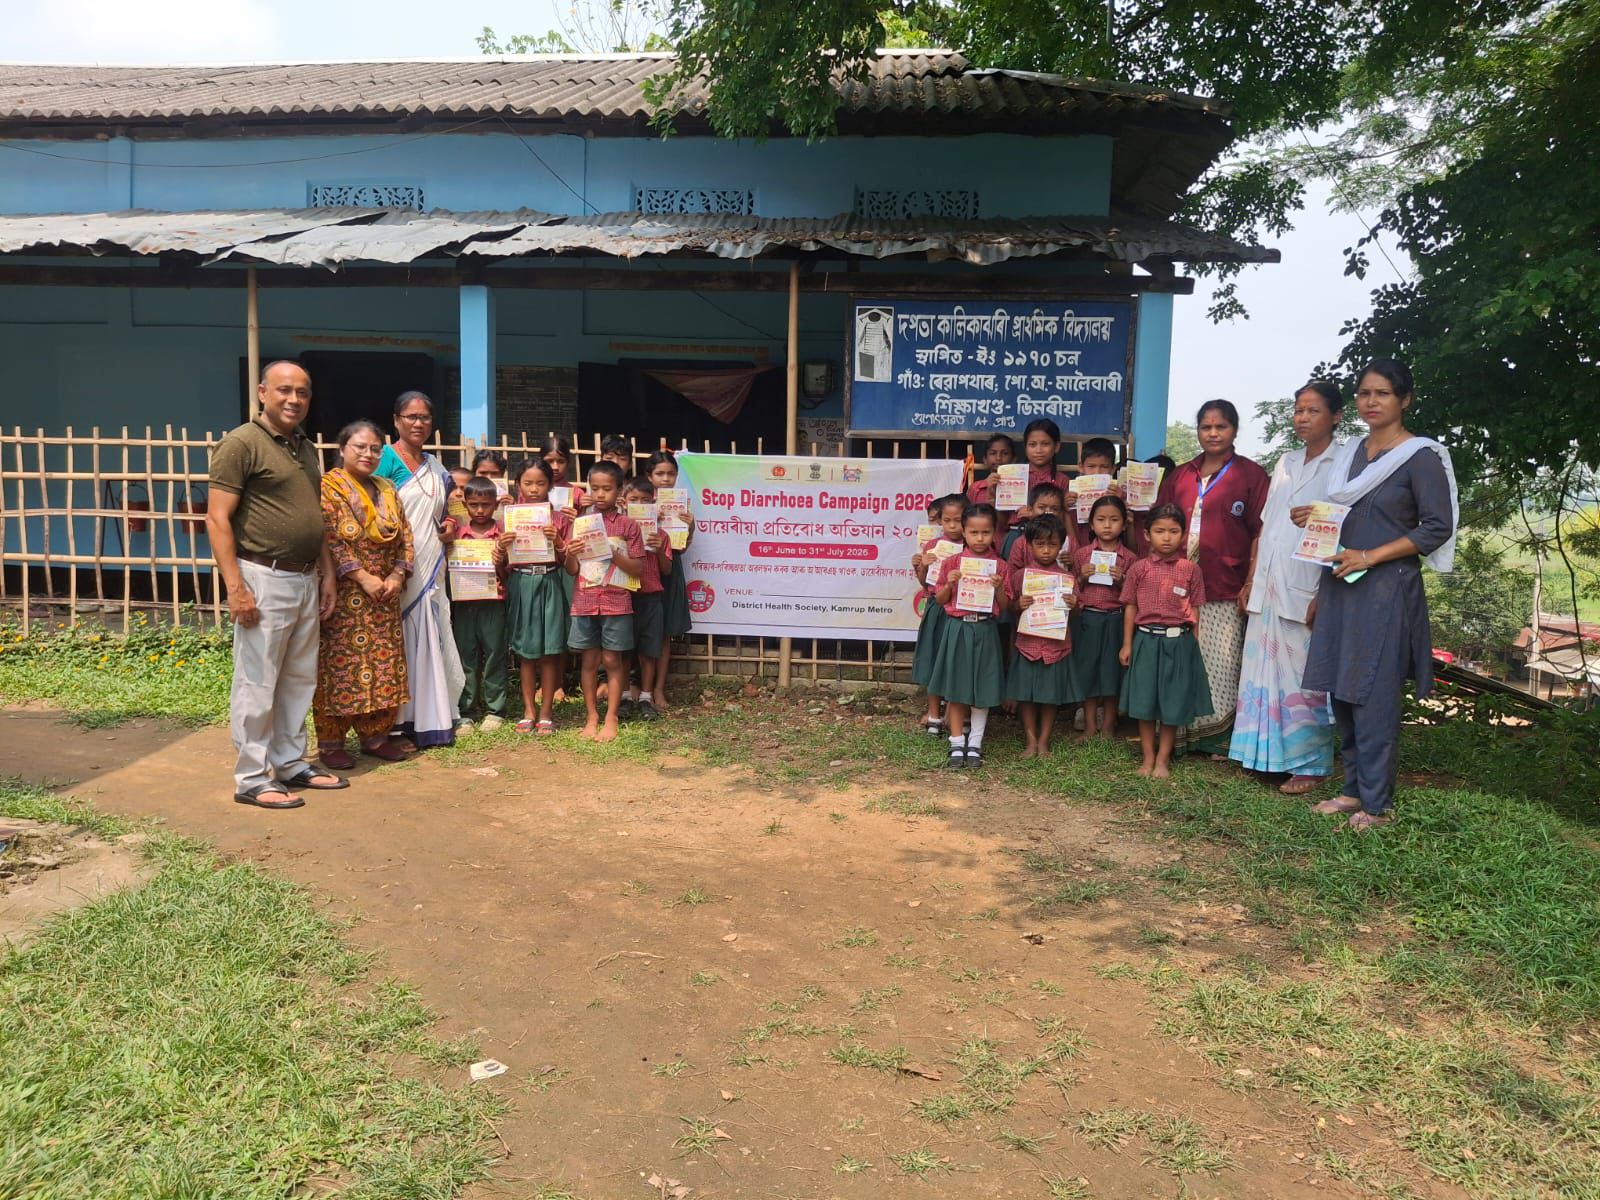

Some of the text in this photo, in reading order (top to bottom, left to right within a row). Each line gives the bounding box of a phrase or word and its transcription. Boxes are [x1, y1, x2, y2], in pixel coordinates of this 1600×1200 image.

[1003, 350, 1051, 367] ১৯৭০
[1054, 350, 1082, 367] চন
[974, 416, 988, 426] A+
[702, 488, 735, 510] Stop
[741, 489, 813, 509] Diarrhoea
[819, 491, 889, 514] Campaign
[895, 493, 934, 511] 2026
[829, 519, 885, 539] অভিযান
[892, 525, 919, 540] ২০
[776, 546, 796, 555] June
[798, 547, 807, 555] to
[827, 548, 844, 557] July
[724, 588, 753, 596] VENUE
[732, 601, 893, 614] District Health Society, Kamrup Metro
